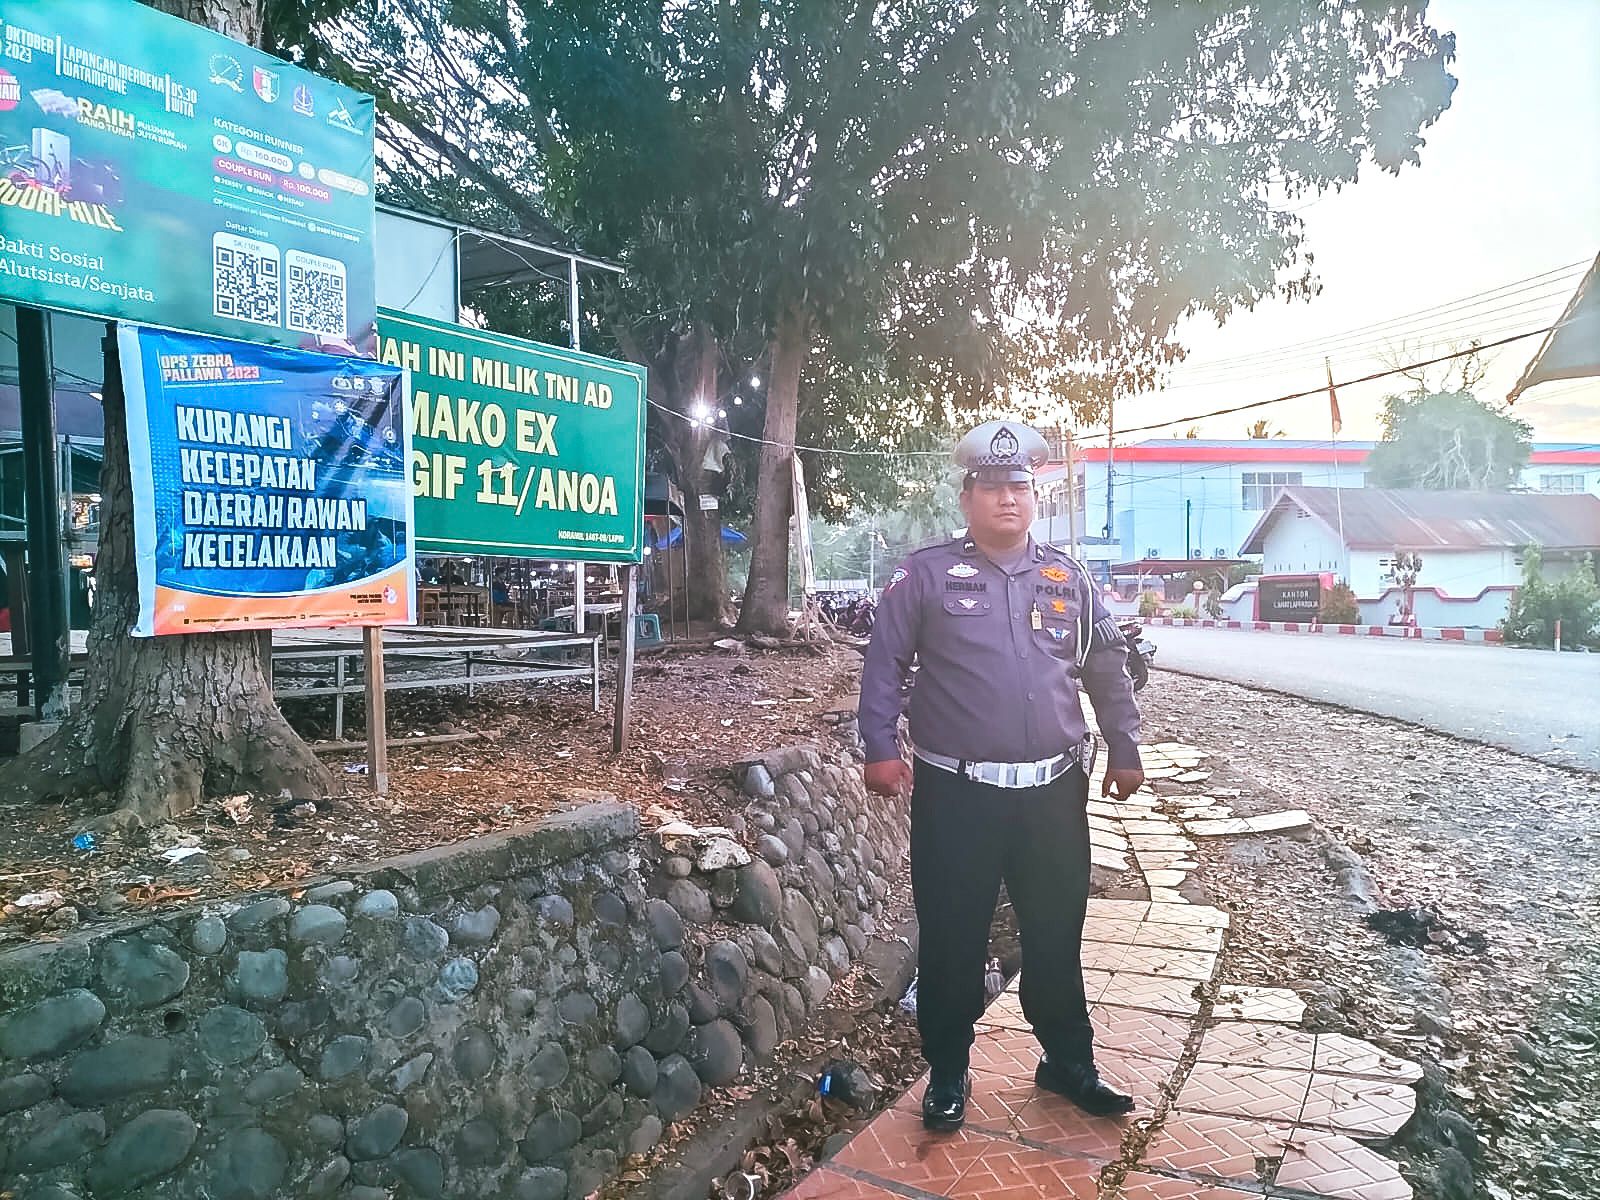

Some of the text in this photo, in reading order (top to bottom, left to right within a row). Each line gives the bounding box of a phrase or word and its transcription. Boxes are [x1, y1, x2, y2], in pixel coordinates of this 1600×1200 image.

[5, 24, 54, 55] OKTOBER
[5, 41, 32, 64] 2023
[62, 59, 128, 96] WATAMPONE
[63, 44, 165, 93] LAPANGAN MERDEKA
[77, 96, 135, 131] RAIH
[171, 100, 195, 118] WITA
[213, 117, 305, 155] KATEGORI RUNNER
[218, 159, 273, 184] COUPLE RUN
[49, 246, 105, 271] Sosial
[0, 258, 155, 302] Alutsista/Senjata
[160, 354, 234, 369] OPS ZEBRA
[162, 365, 260, 382] PALLAWA 2023
[429, 347, 465, 382] INI
[472, 356, 540, 396] MILIK
[545, 371, 580, 405] TNI
[583, 381, 613, 409] AD
[176, 405, 293, 450] KURANGI
[411, 390, 560, 457] MAKO EX
[180, 448, 316, 491] KECEPATAN
[476, 458, 619, 517] 11/ANOA
[183, 490, 367, 531] DAERAH RAWAN
[183, 533, 337, 569] KECELAKAAN
[945, 580, 986, 593] HERMAN
[1035, 584, 1077, 601] POLRI
[1282, 590, 1309, 601] KANTOR
